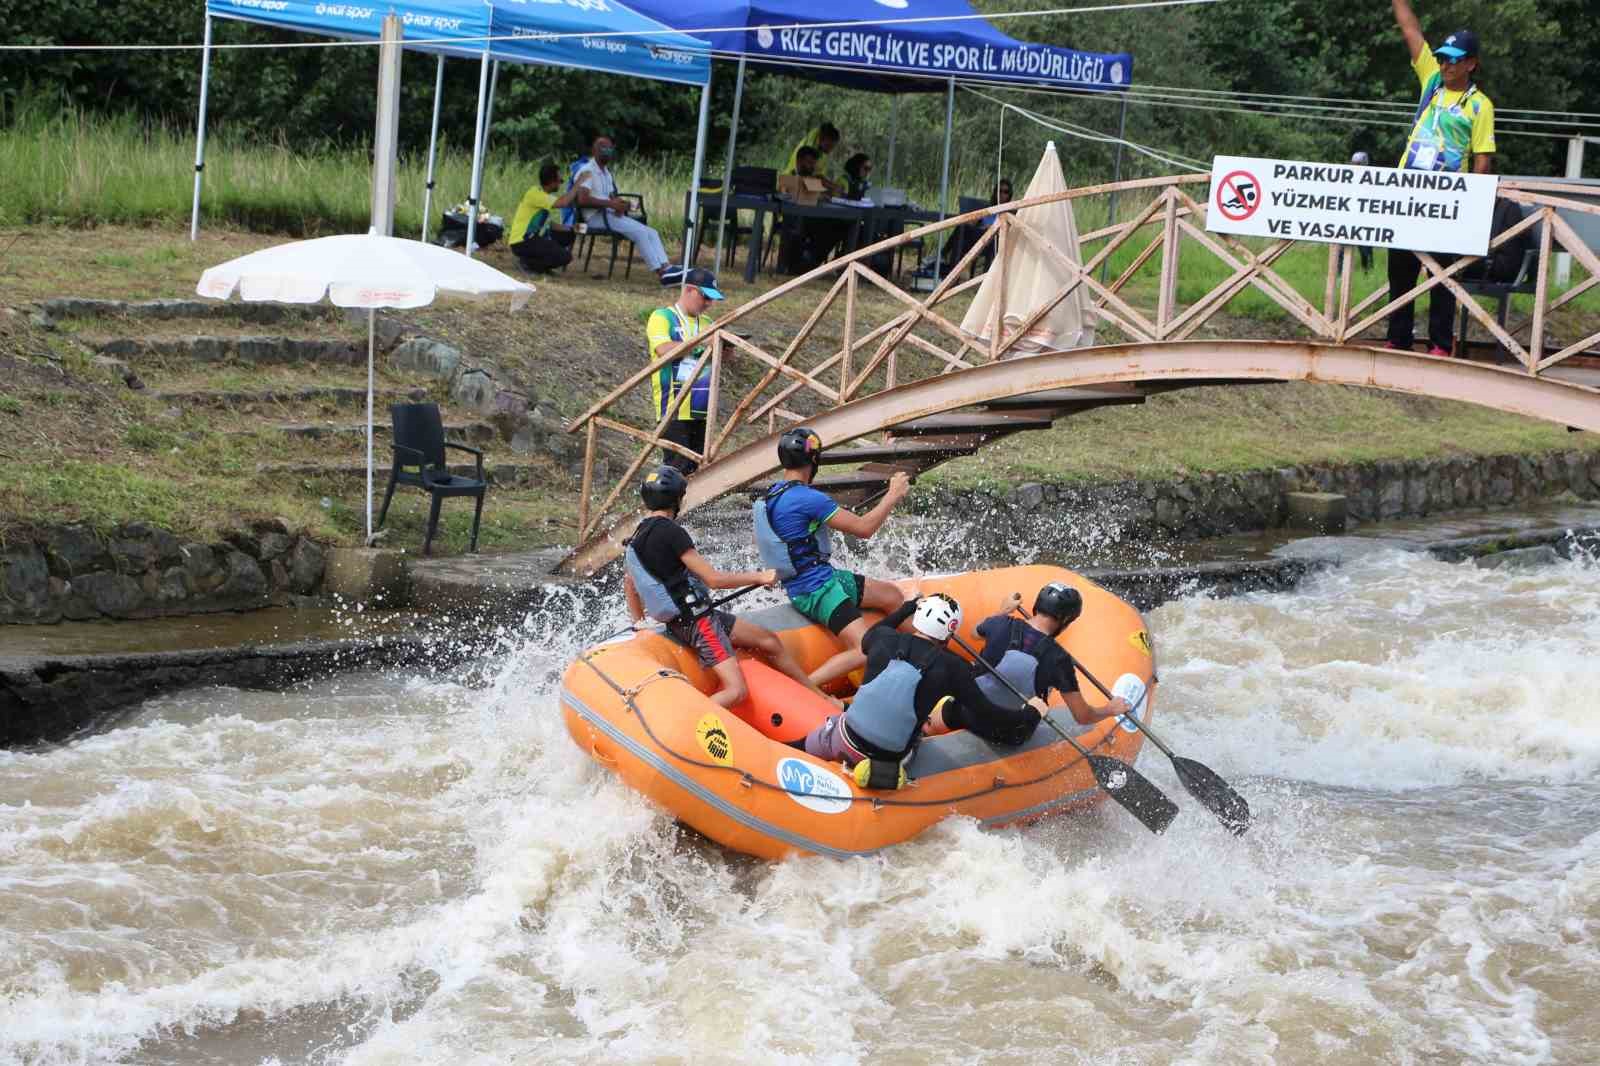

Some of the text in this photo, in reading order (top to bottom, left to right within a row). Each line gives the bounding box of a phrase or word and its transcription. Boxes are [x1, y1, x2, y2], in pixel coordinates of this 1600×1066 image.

[781, 25, 1105, 83] RİZE GENÇLİK VE SPOR İL MÜDÜRLÜĞÜ
[1274, 164, 1467, 192] PARKUR ALANINDA
[1271, 188, 1460, 220] YÜZMEK TEHLİKELİ
[1267, 218, 1395, 243] VE YASAKTIR
